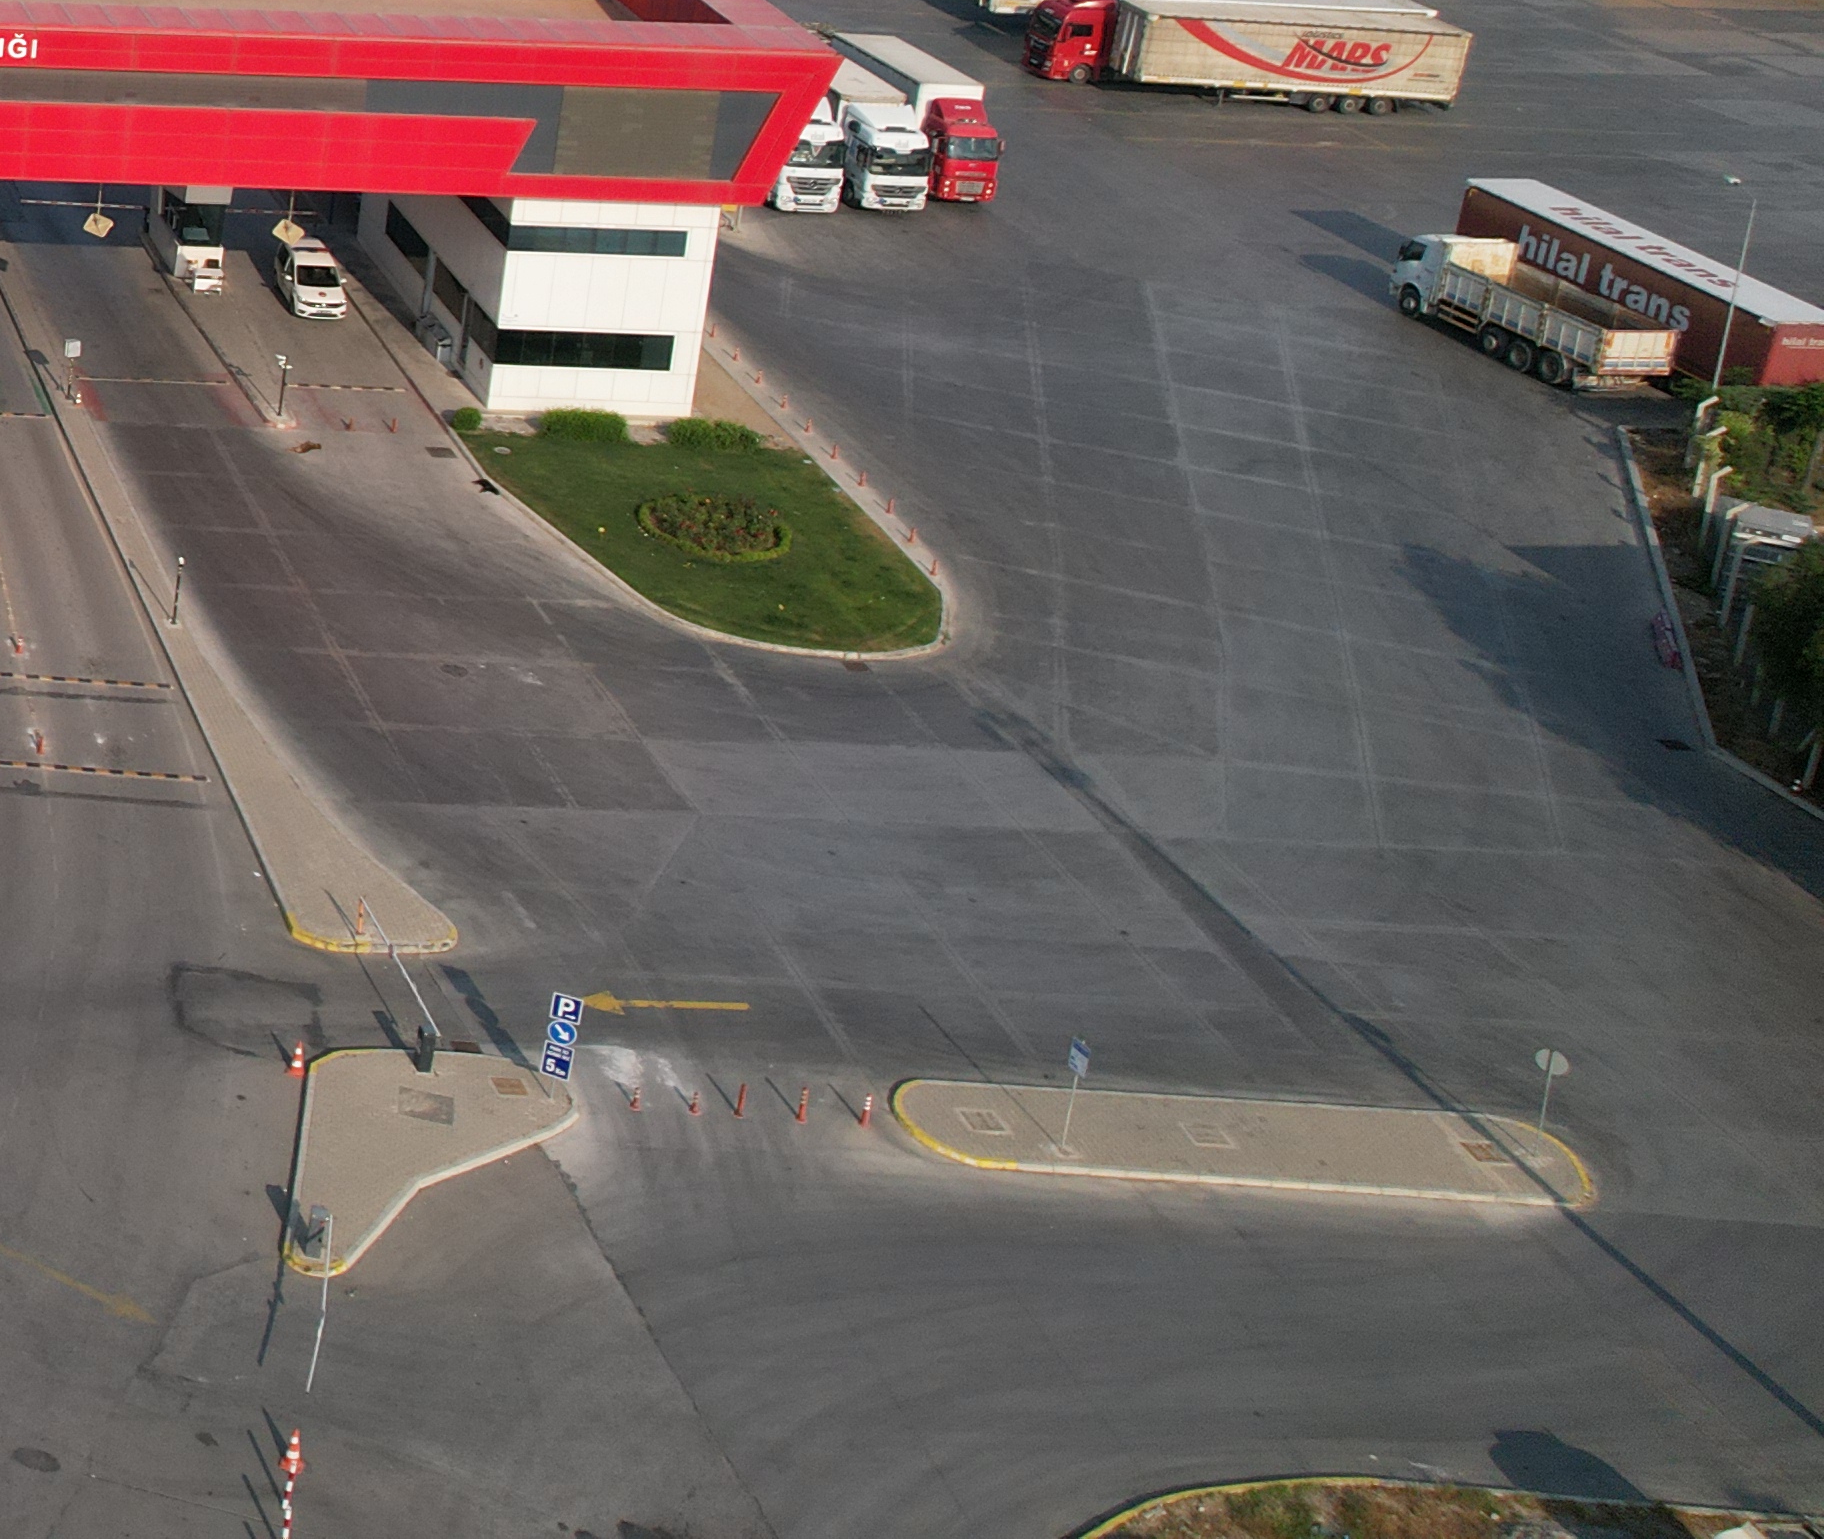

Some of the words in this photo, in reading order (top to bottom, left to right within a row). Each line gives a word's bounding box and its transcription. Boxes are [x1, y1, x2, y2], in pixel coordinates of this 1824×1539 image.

[1283, 38, 1393, 73] MARS
[1518, 224, 1591, 285] hilal
[1598, 262, 1692, 333] trans
[557, 997, 576, 1017] P
[545, 1057, 556, 1072] 5
